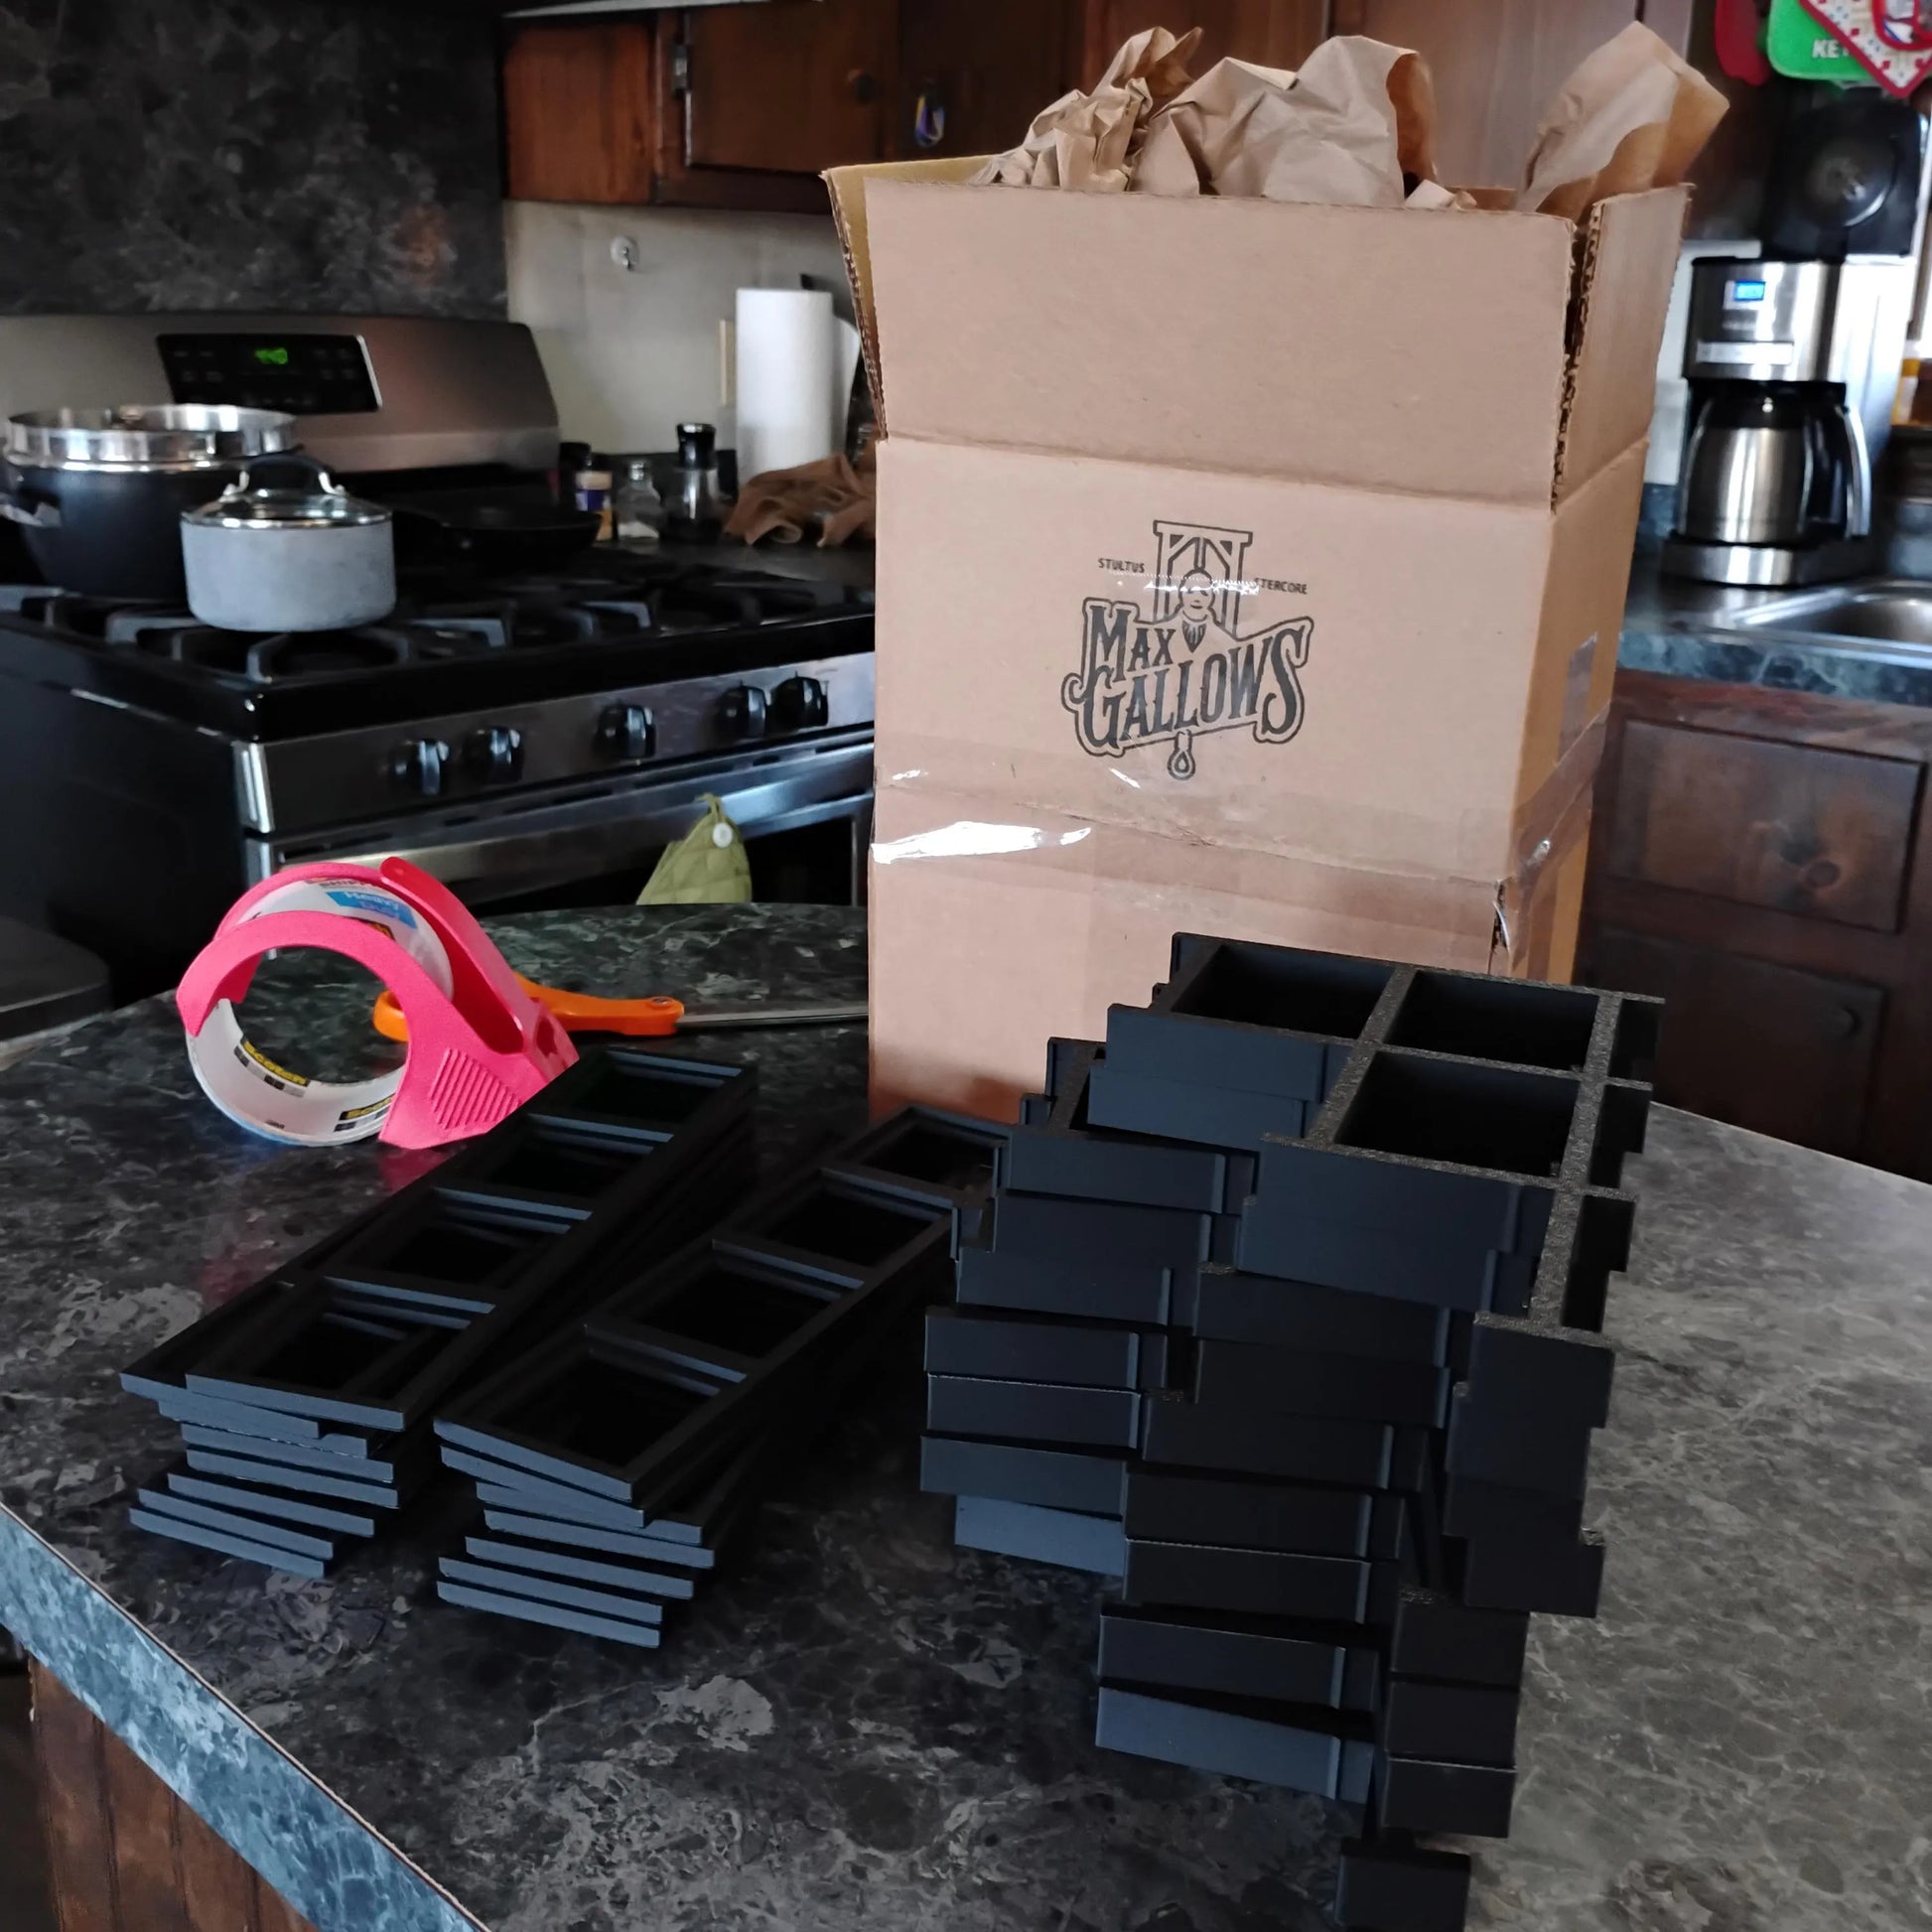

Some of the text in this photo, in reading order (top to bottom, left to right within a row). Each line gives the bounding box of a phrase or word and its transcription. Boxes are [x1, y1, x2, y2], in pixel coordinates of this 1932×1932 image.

[1812, 39, 1850, 59] KE
[1097, 557, 1145, 574] STULTUS
[1089, 605, 1176, 683] MAX
[1068, 625, 1307, 749] GALLOWS
[243, 1040, 308, 1086] Scotch
